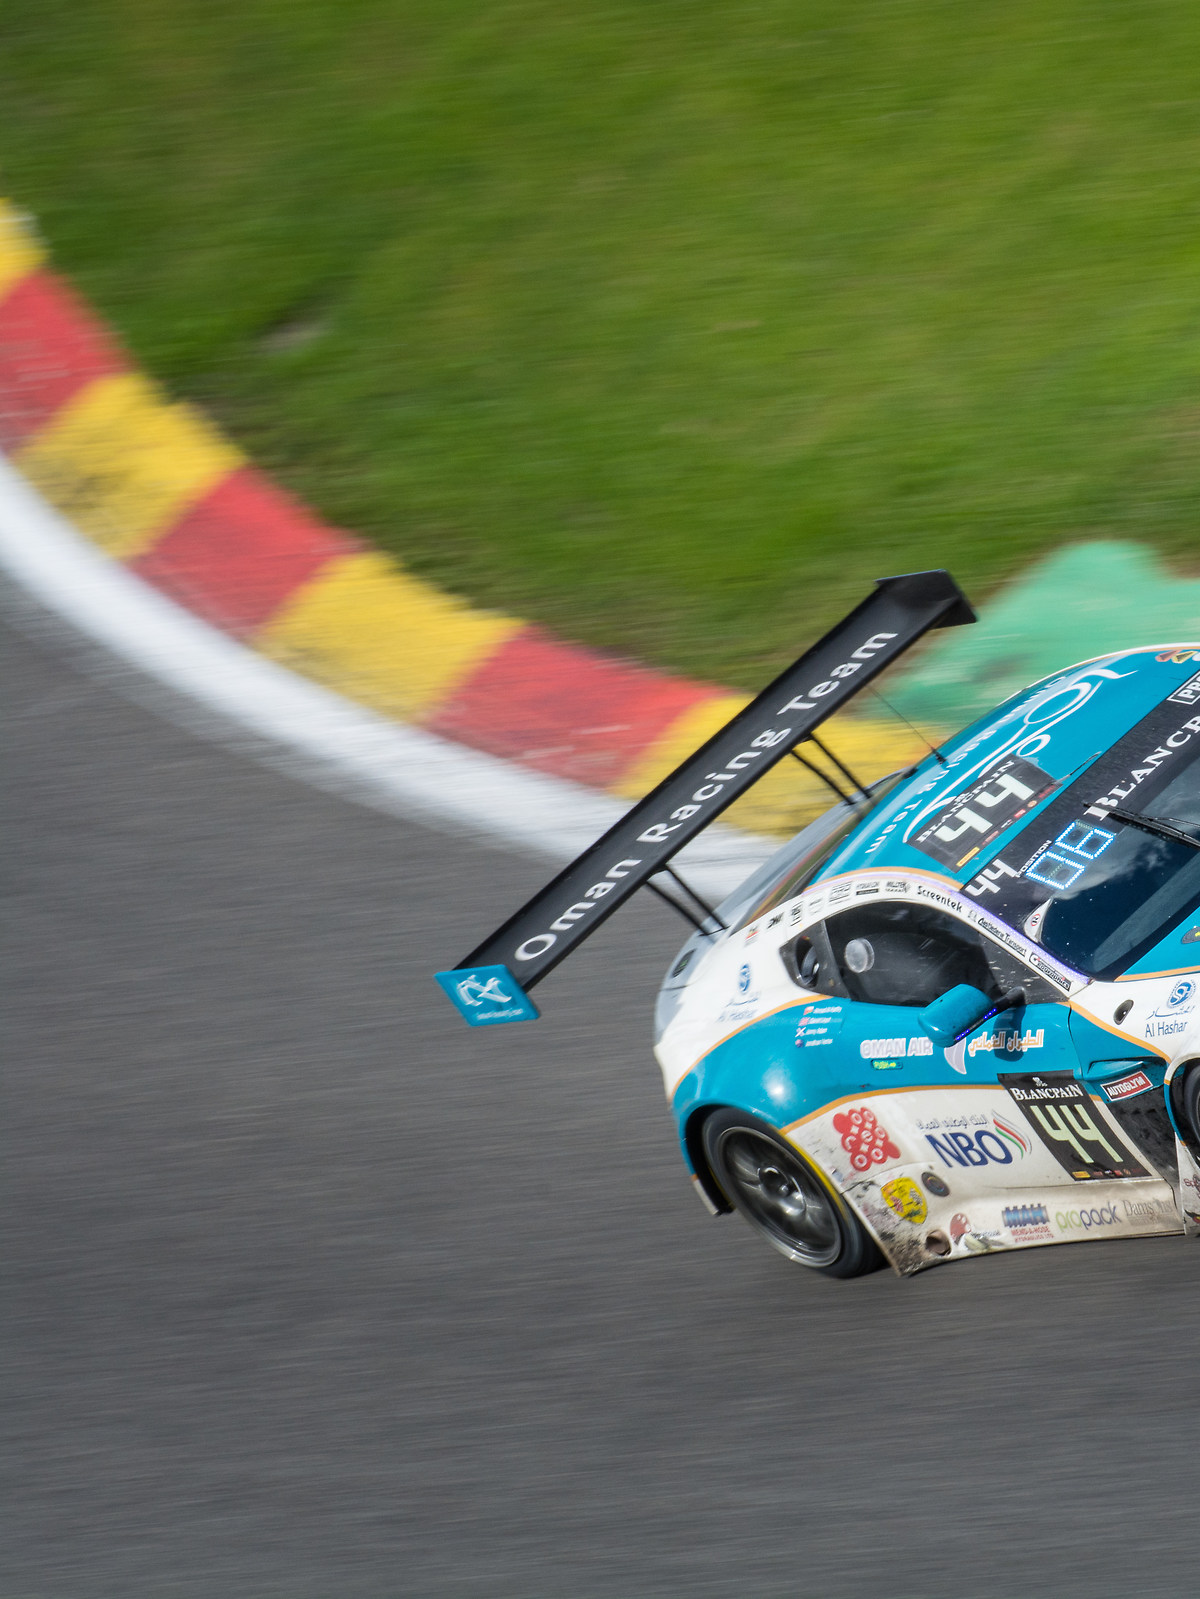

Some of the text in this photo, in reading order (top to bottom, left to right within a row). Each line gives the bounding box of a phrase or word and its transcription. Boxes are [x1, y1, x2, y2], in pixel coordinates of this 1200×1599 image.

[514, 632, 898, 961] Oman Racing Team
[916, 761, 1016, 844] BLANCPAIN
[935, 773, 1034, 842] 44
[1017, 840, 1052, 877] POSITION
[964, 859, 1019, 897] 44
[917, 885, 963, 913] Screentek
[1145, 1020, 1188, 1038] Al Hashar
[860, 1037, 933, 1059] OMAN AIR
[1010, 1084, 1084, 1101] BLANCPAIN
[1107, 1076, 1146, 1097] AUTOGLYM
[925, 1130, 1013, 1168] NBO
[1029, 1104, 1124, 1163] 44
[1056, 1203, 1121, 1232] propack
